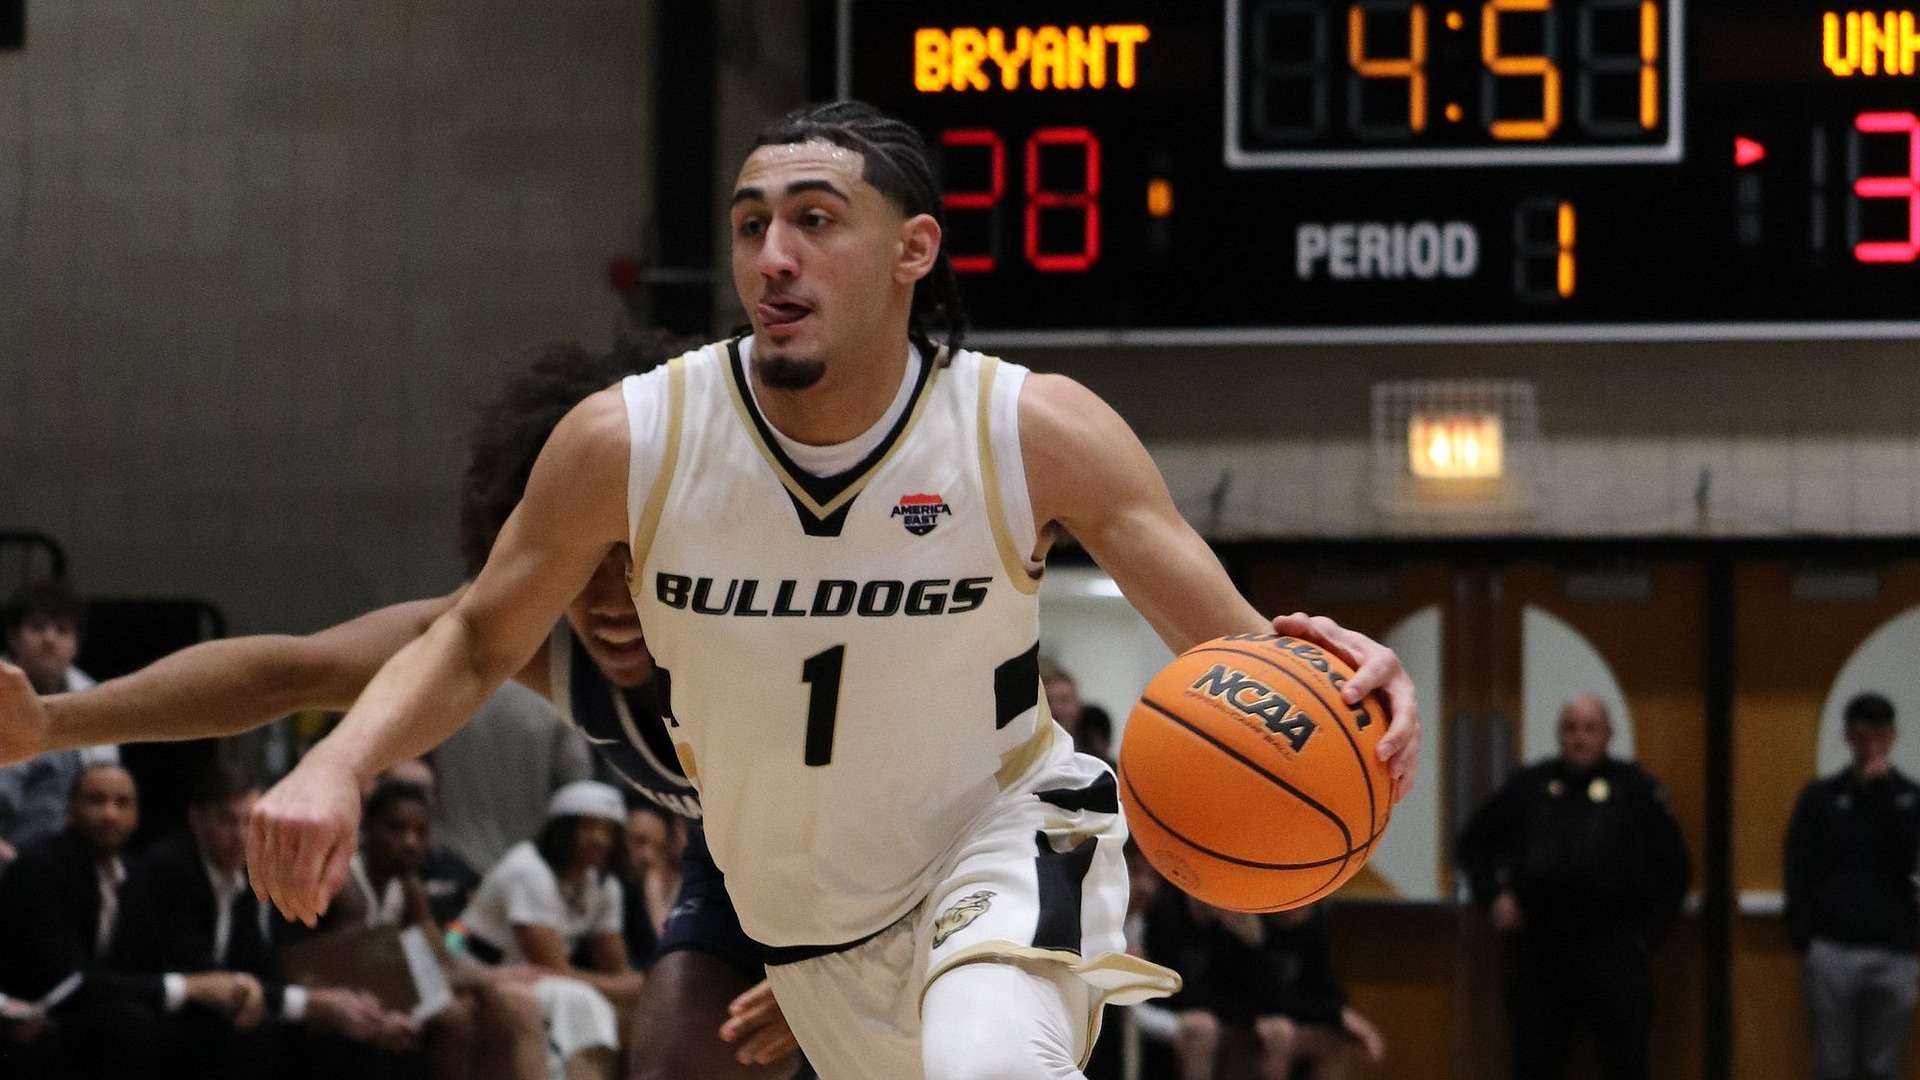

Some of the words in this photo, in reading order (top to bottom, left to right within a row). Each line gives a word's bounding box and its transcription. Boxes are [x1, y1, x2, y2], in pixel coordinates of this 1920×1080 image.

[913, 23, 1151, 93] BRYANT
[1347, 0, 1660, 140] 4:51
[1296, 221, 1480, 279] PERIOD
[1556, 201, 1577, 299] 1
[890, 503, 953, 518] AMERICA
[904, 514, 938, 525] EAST
[656, 571, 994, 617] BULLDOGS
[801, 644, 846, 767] 1
[1189, 663, 1316, 754] NCAA
